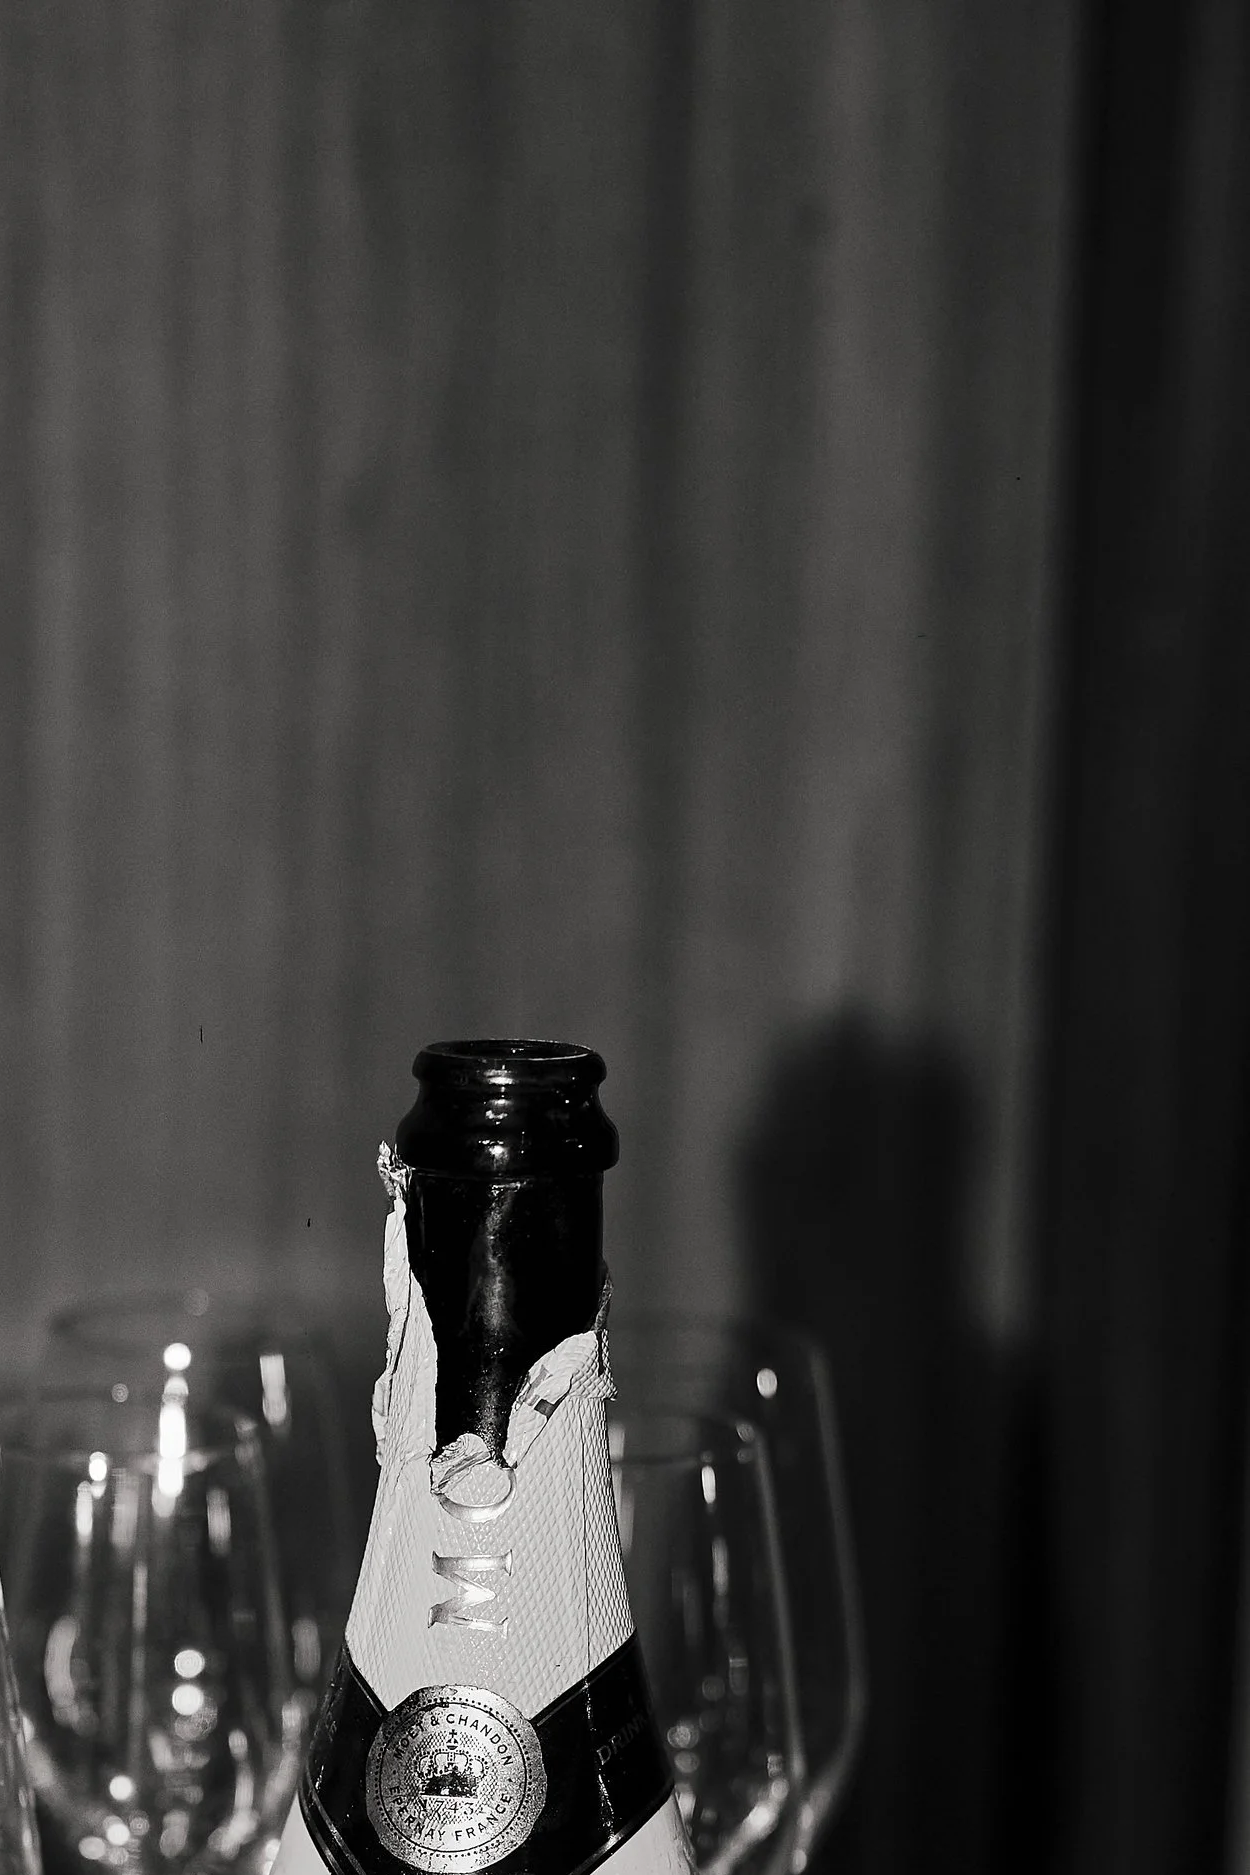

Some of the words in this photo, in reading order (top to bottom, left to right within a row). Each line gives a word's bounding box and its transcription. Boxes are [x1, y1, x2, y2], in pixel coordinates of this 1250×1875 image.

[430, 1714, 440, 1727] &
[446, 1712, 514, 1767] CHANDON
[454, 1793, 513, 1842] FRANCE
